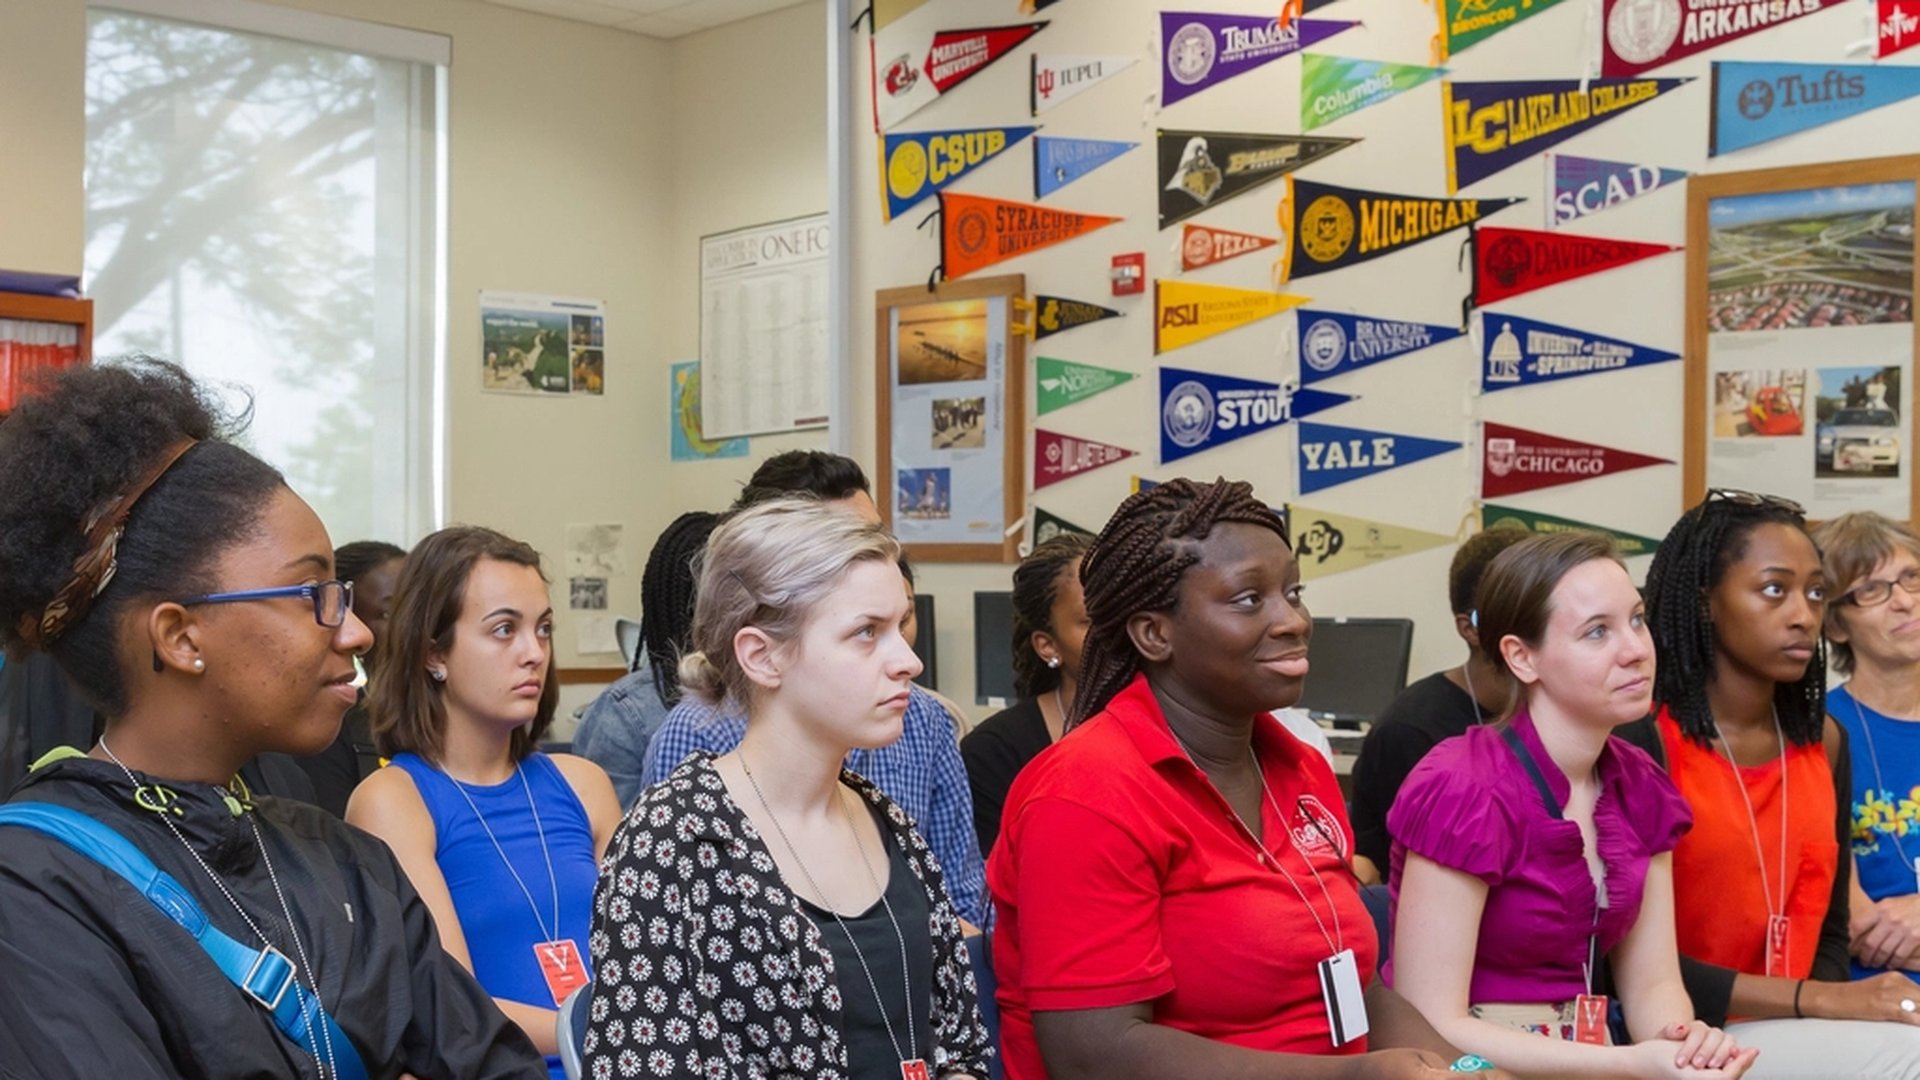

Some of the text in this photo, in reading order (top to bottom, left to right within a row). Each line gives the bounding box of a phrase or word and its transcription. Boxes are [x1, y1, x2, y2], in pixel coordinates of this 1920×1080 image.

[1220, 17, 1299, 54] TRUMAN
[1683, 0, 1821, 46] ARKANSAS
[931, 35, 987, 65] MARYVILLE
[932, 49, 989, 82] UNIVERSITY
[1060, 61, 1102, 86] IUPUI
[1777, 69, 1866, 107] Tufts
[1314, 72, 1393, 115] Columbia
[1452, 99, 1508, 154] LC
[1508, 80, 1659, 144] LAKELAND COLLEGE
[928, 130, 1006, 185] CSUB
[1554, 164, 1662, 227] SCAD
[995, 204, 1086, 233] SYRACUSE
[1359, 199, 1480, 254] MICHIGAN
[761, 227, 802, 261] ONE
[997, 226, 1082, 256] UNIVERSITY
[1213, 232, 1261, 260] TEXAS
[1534, 241, 1640, 277] DAVIDSON
[1161, 303, 1198, 329] ASU
[1350, 332, 1433, 362] UNIVERSITY
[1217, 398, 1293, 430] STOUT
[1301, 438, 1395, 470] YALE
[1515, 455, 1604, 475] CHICAGO
[544, 945, 569, 973] V
[1583, 1000, 1602, 1031] V
